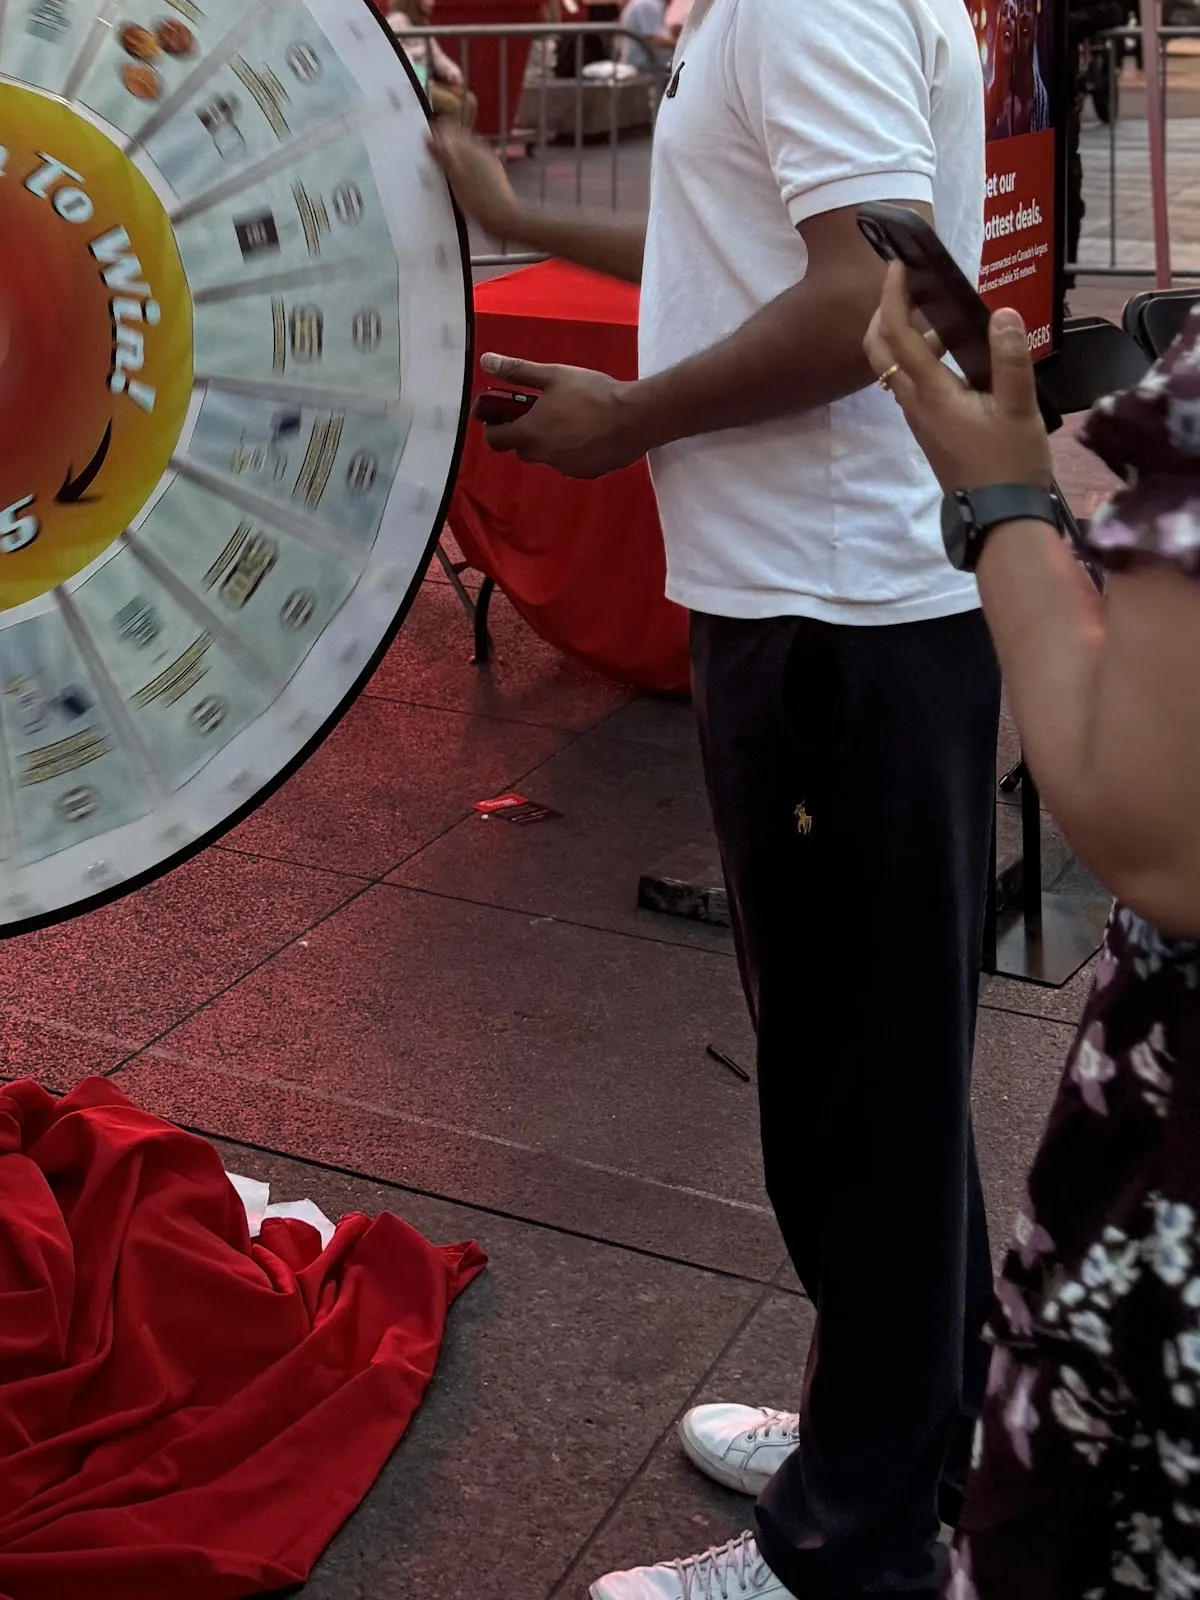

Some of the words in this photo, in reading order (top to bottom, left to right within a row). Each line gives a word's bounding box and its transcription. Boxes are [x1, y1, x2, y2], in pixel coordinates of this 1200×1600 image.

[999, 170, 1017, 195] our
[1015, 197, 1044, 232] deals.
[87, 224, 162, 414] Win!
[1026, 323, 1051, 351] OGERS
